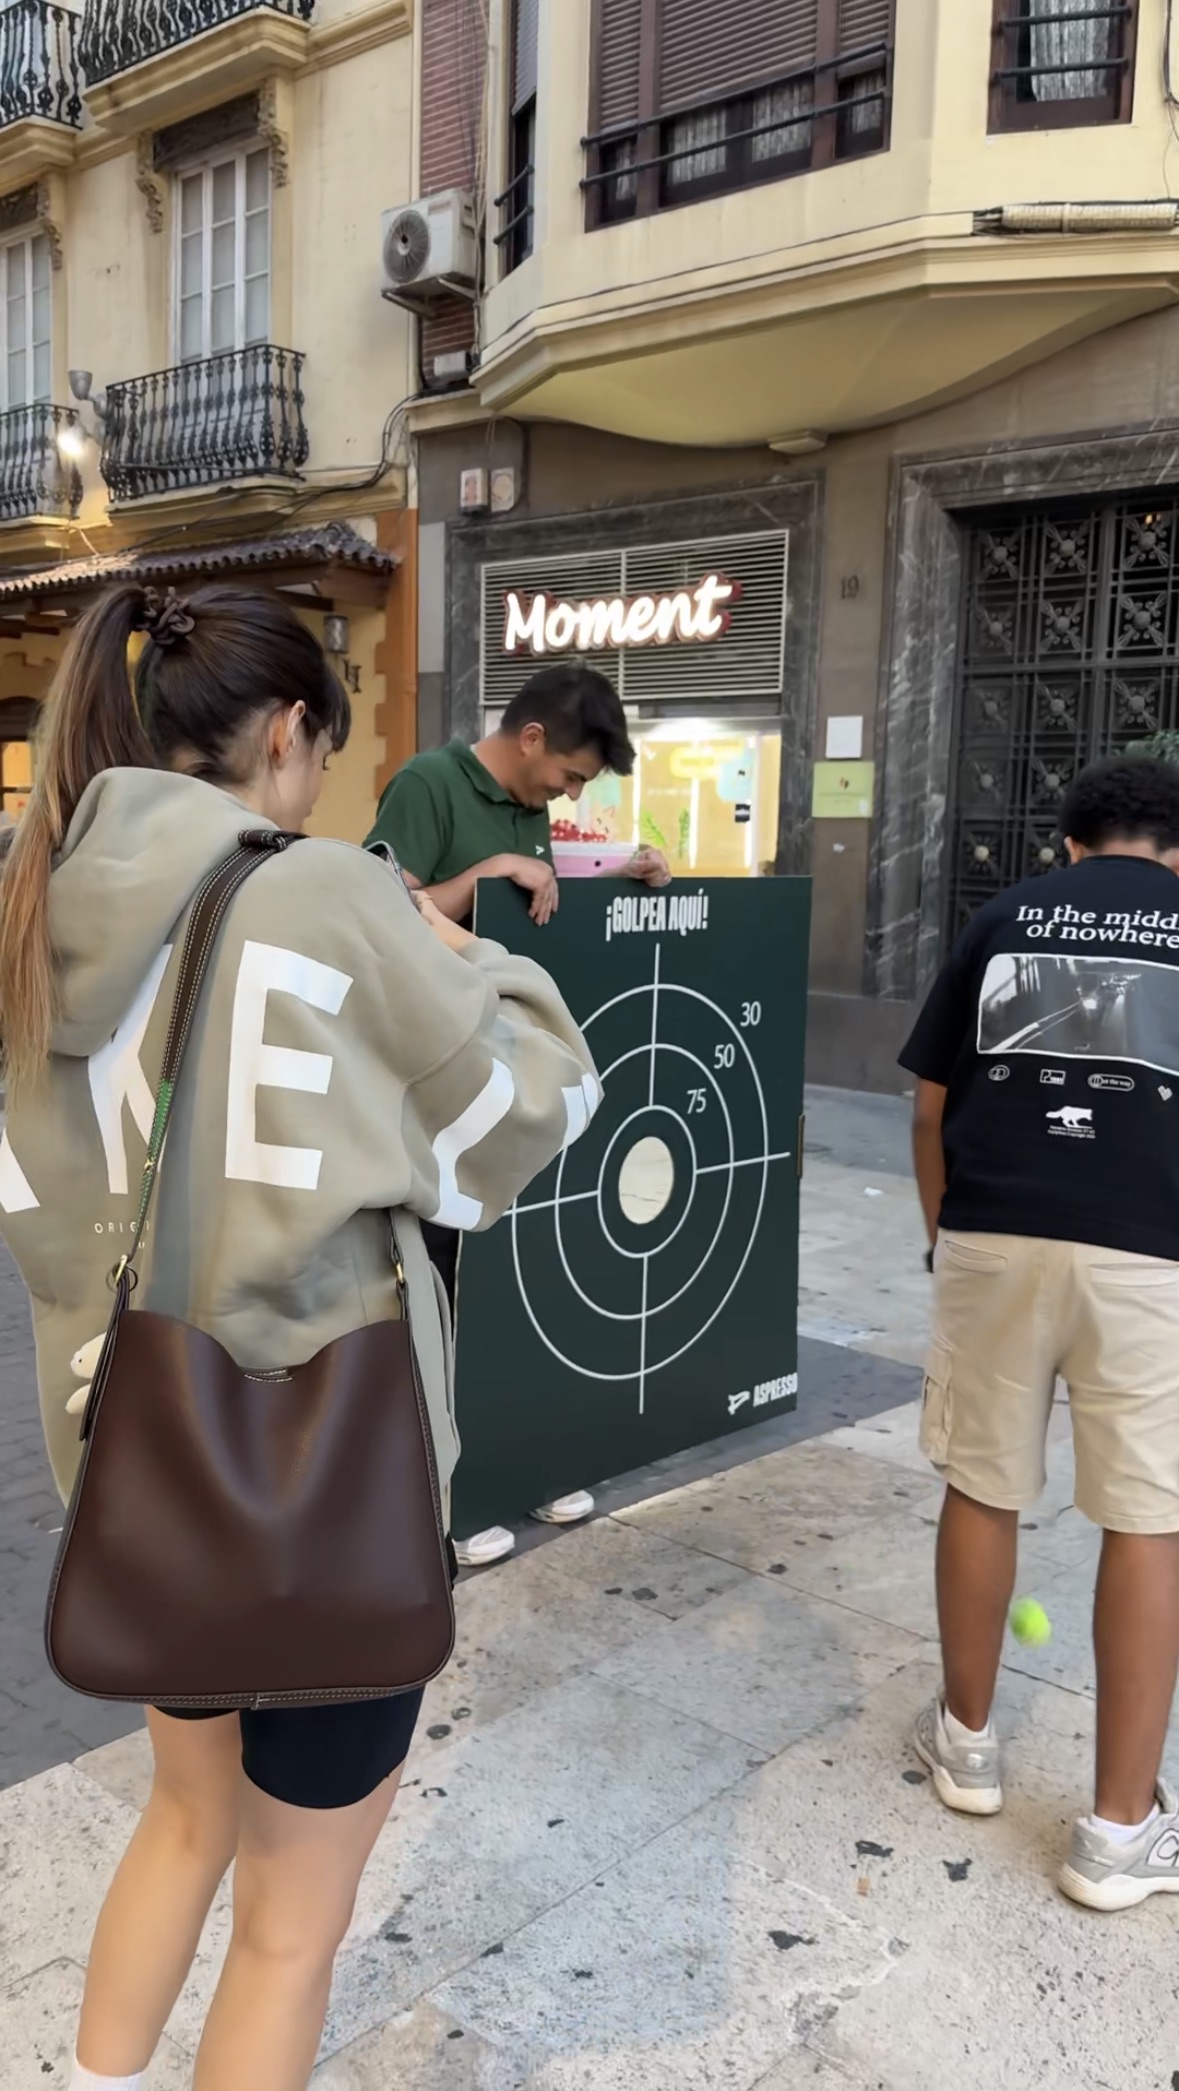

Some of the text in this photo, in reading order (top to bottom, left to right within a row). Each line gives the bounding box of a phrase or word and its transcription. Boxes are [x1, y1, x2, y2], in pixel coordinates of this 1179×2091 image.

[841, 575, 860, 599] 19
[505, 574, 733, 653] Moment
[606, 888, 709, 942] ¡GOLPEA AQUÍ!
[1016, 905, 1179, 930] In the midd
[1026, 919, 1179, 948] of nowhere
[740, 1001, 761, 1026] 30
[714, 1043, 735, 1069] 50
[687, 1088, 706, 1114] 75
[753, 1372, 798, 1407] ASPRESSO
